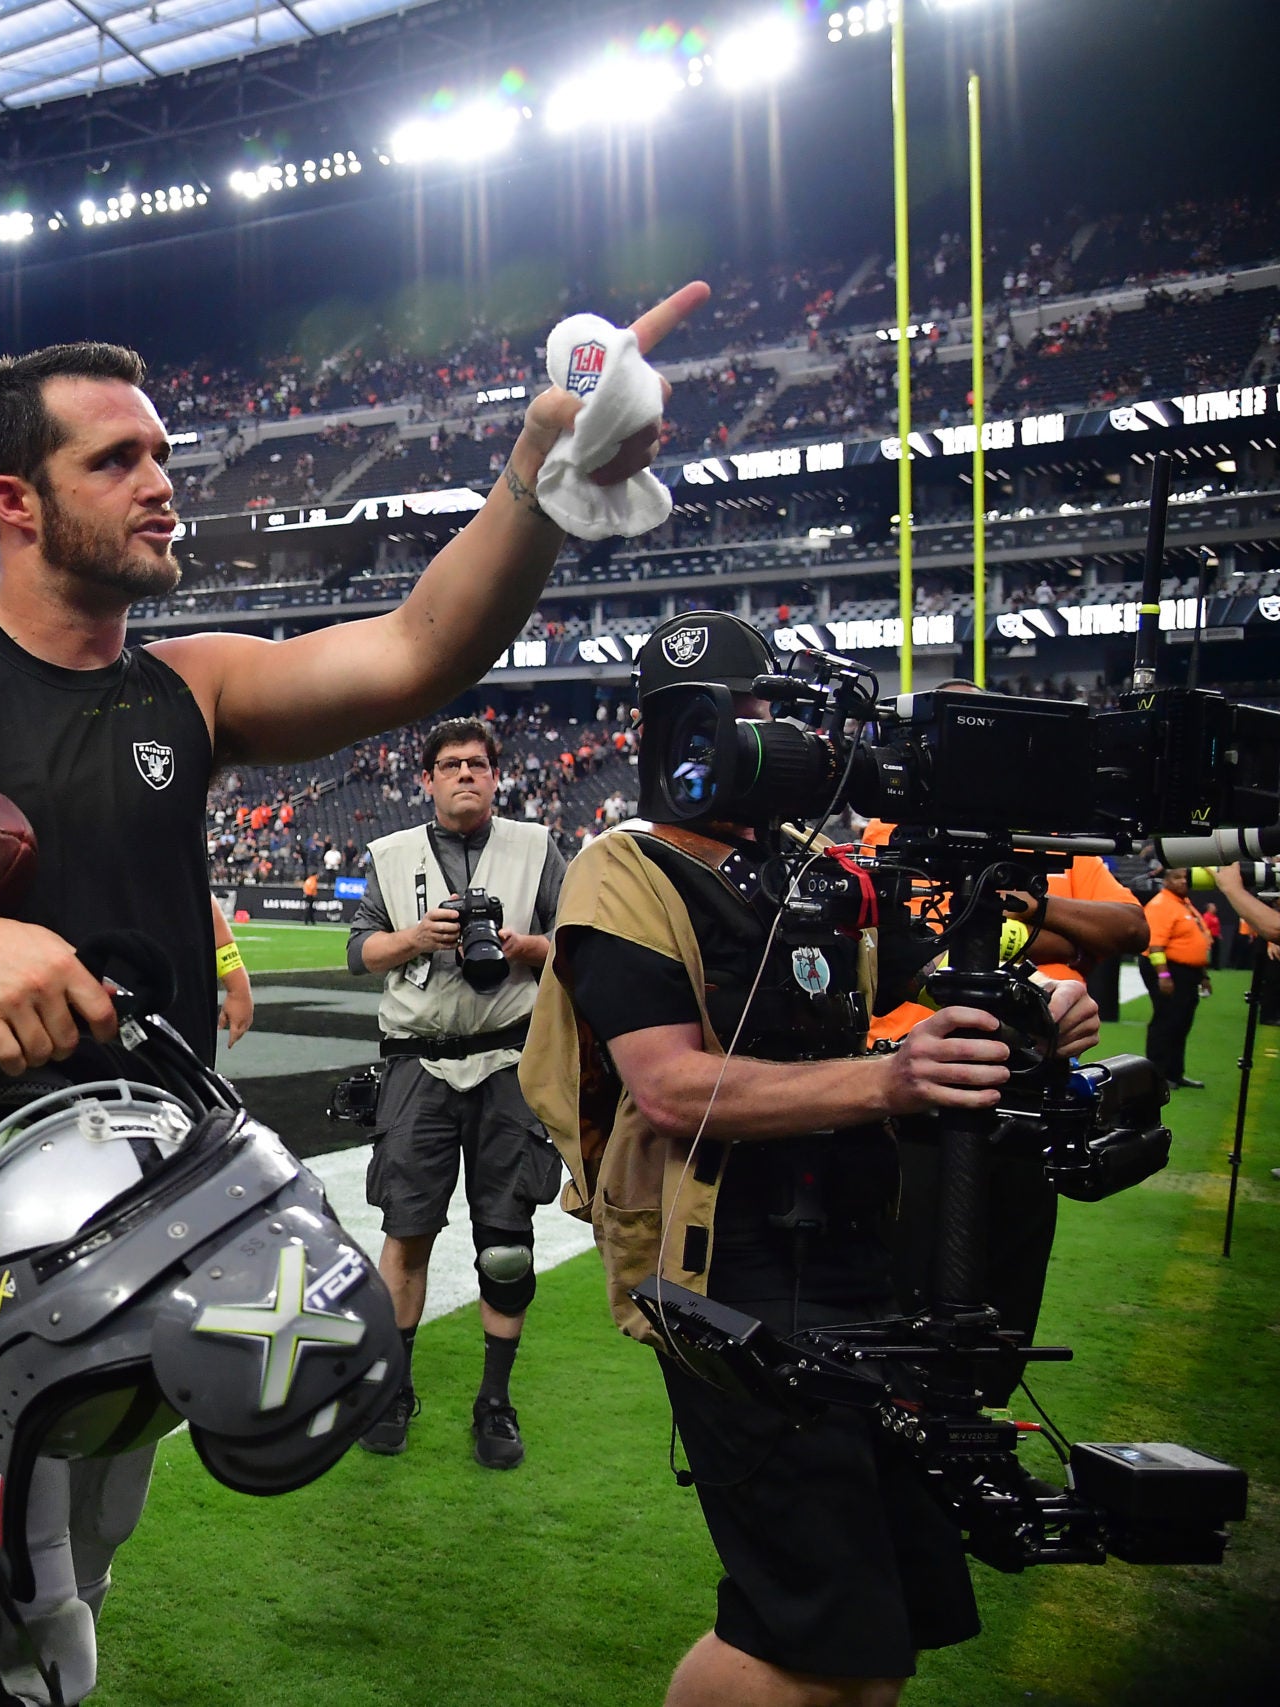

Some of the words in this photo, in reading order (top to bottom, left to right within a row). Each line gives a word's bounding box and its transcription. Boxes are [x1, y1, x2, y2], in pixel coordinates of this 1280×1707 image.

[574, 345, 606, 373] NFL
[666, 630, 702, 643] RAIDERS
[957, 715, 996, 727] SONY
[138, 745, 171, 756] RAIDERS
[882, 763, 904, 771] Canon
